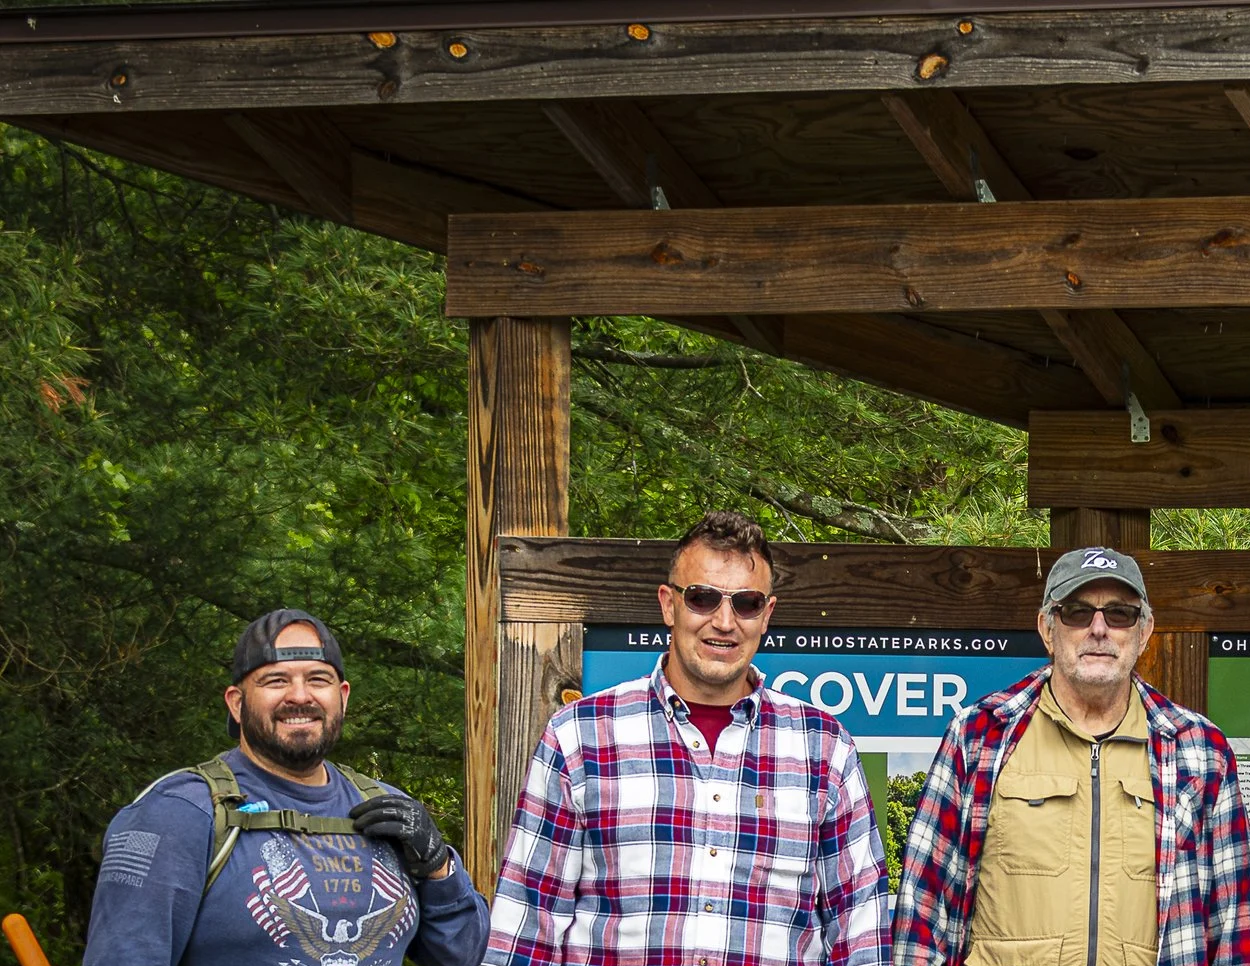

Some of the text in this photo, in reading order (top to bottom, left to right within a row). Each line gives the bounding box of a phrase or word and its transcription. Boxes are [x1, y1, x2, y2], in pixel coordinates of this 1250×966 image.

[764, 635, 786, 647] AT
[796, 636, 1008, 651] OHIOSTATEPARKS.GOV
[312, 855, 363, 873] SINCE
[323, 878, 362, 893] 1776
